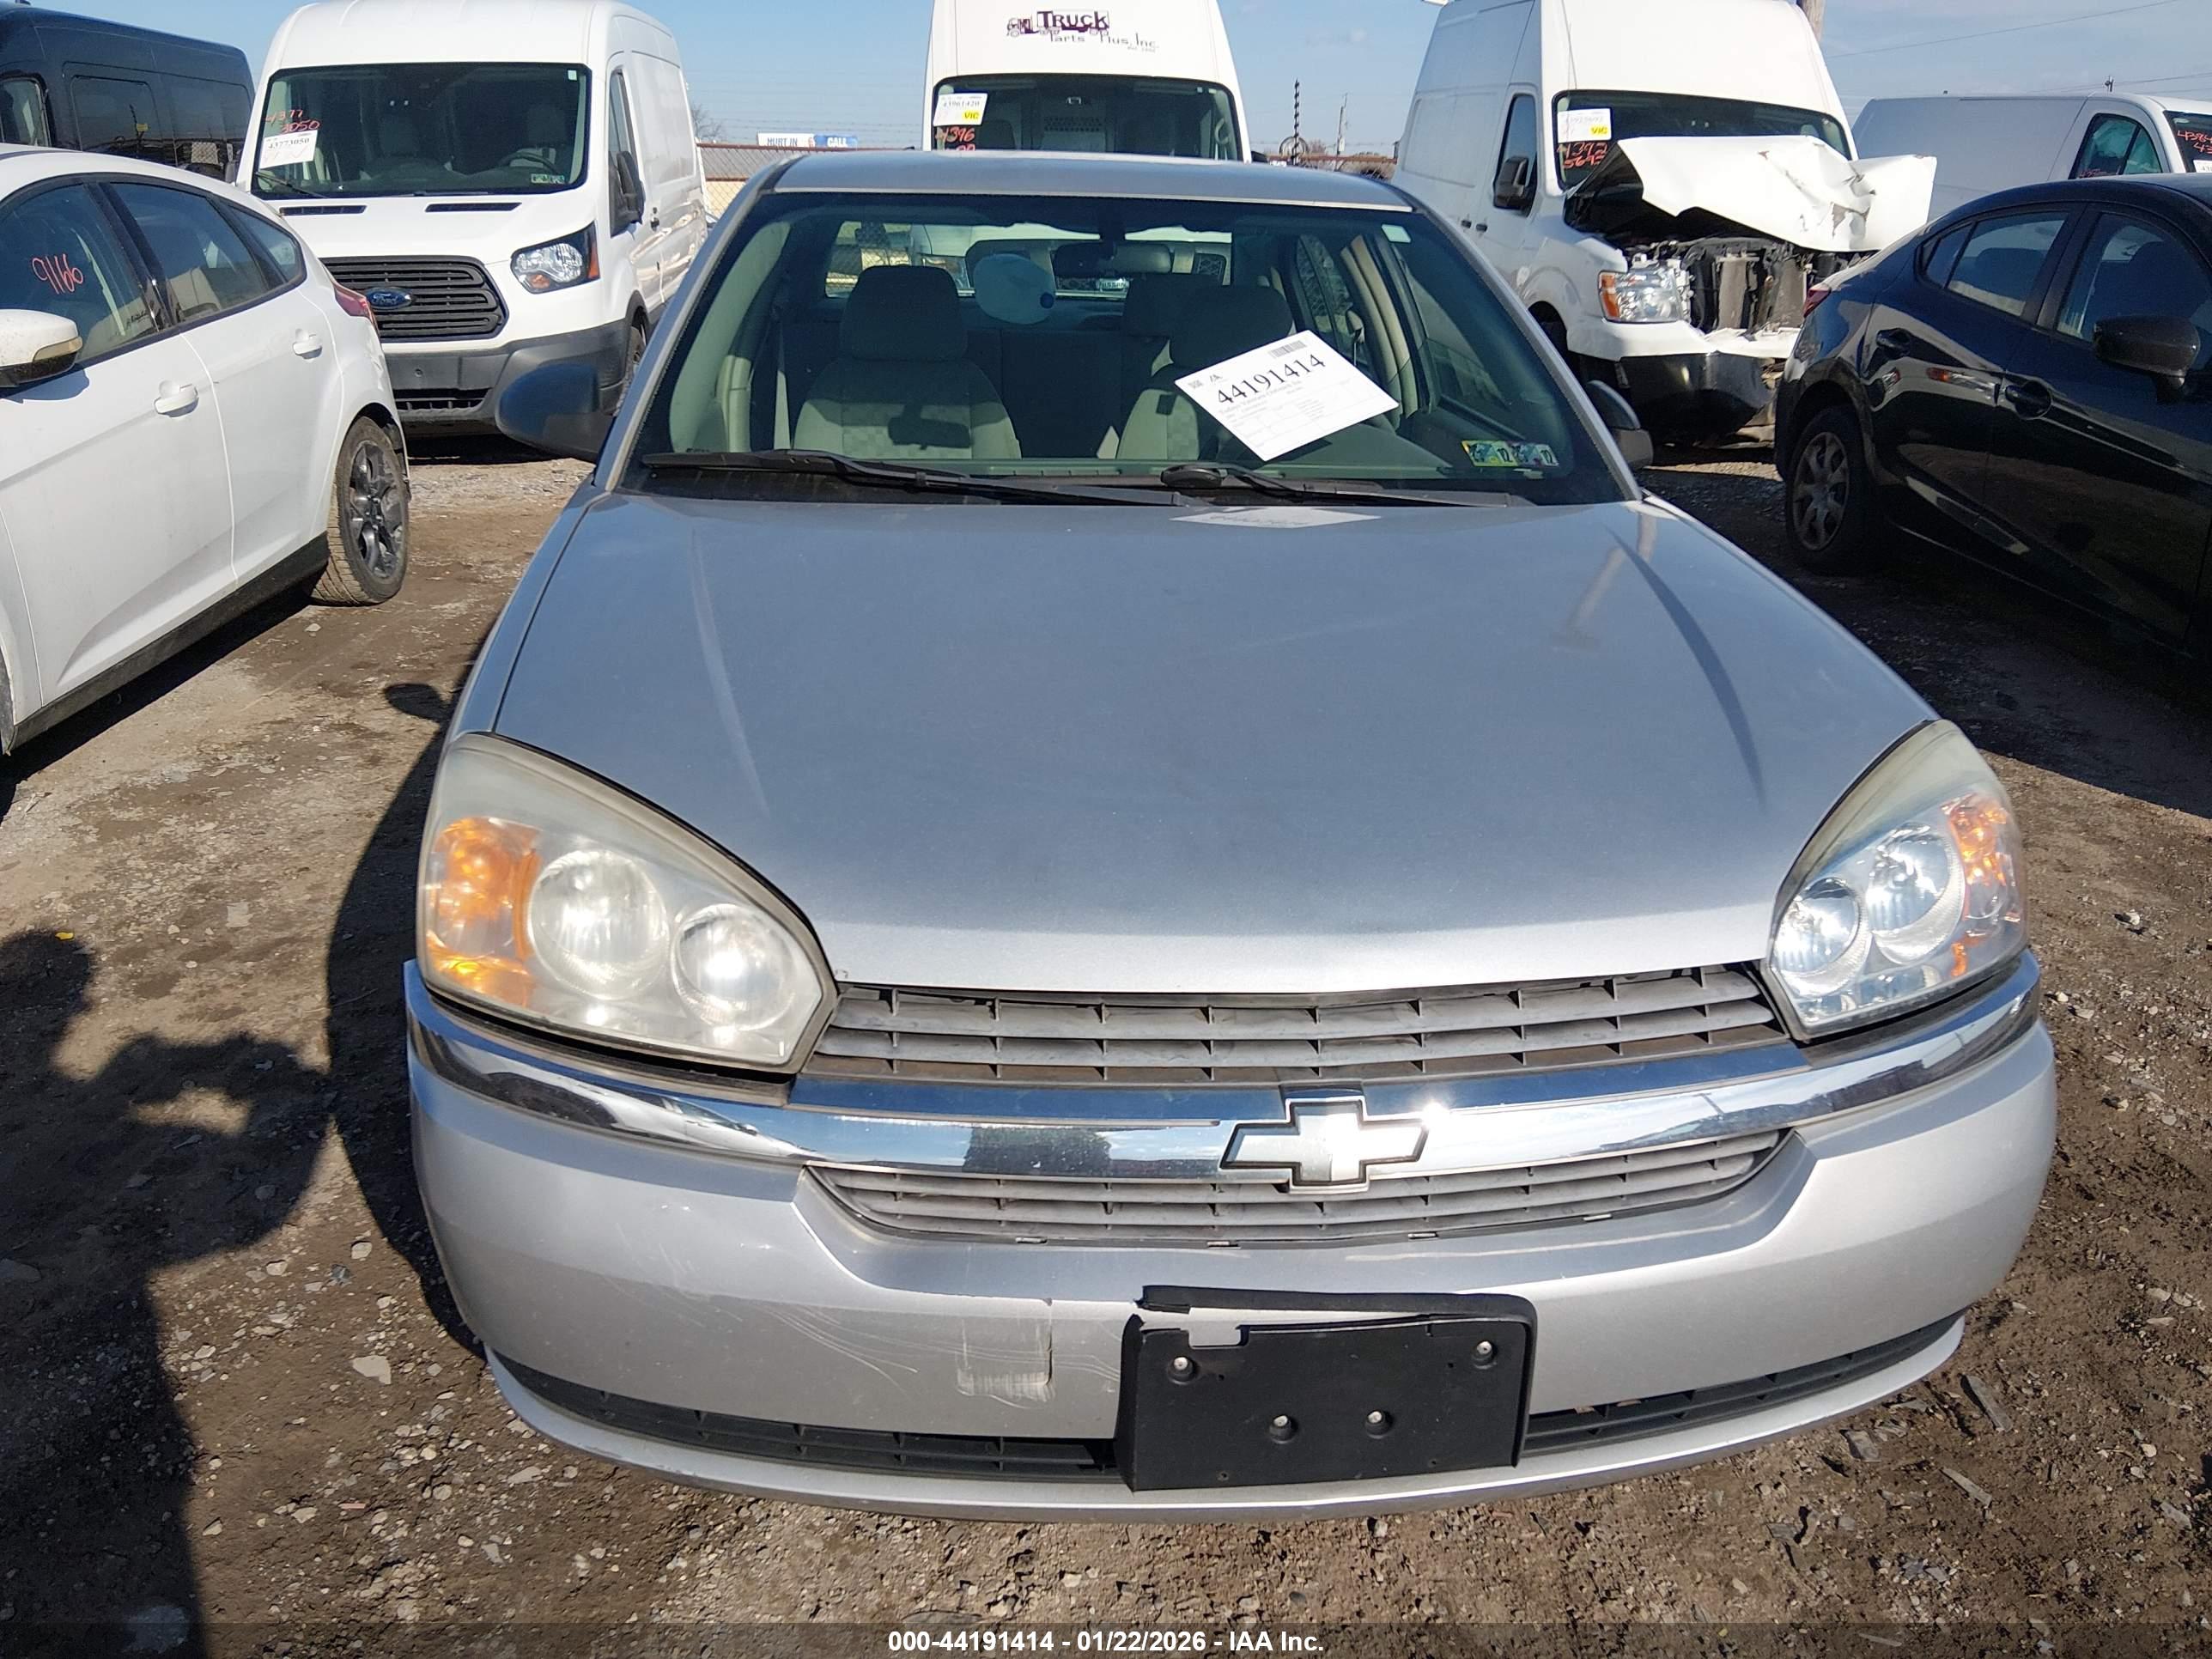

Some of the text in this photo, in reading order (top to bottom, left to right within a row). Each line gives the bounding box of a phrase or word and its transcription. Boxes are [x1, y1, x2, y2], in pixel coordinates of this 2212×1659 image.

[827, 137, 848, 147] CALL
[32, 253, 83, 295] 9166
[1218, 353, 1326, 404] 44191414
